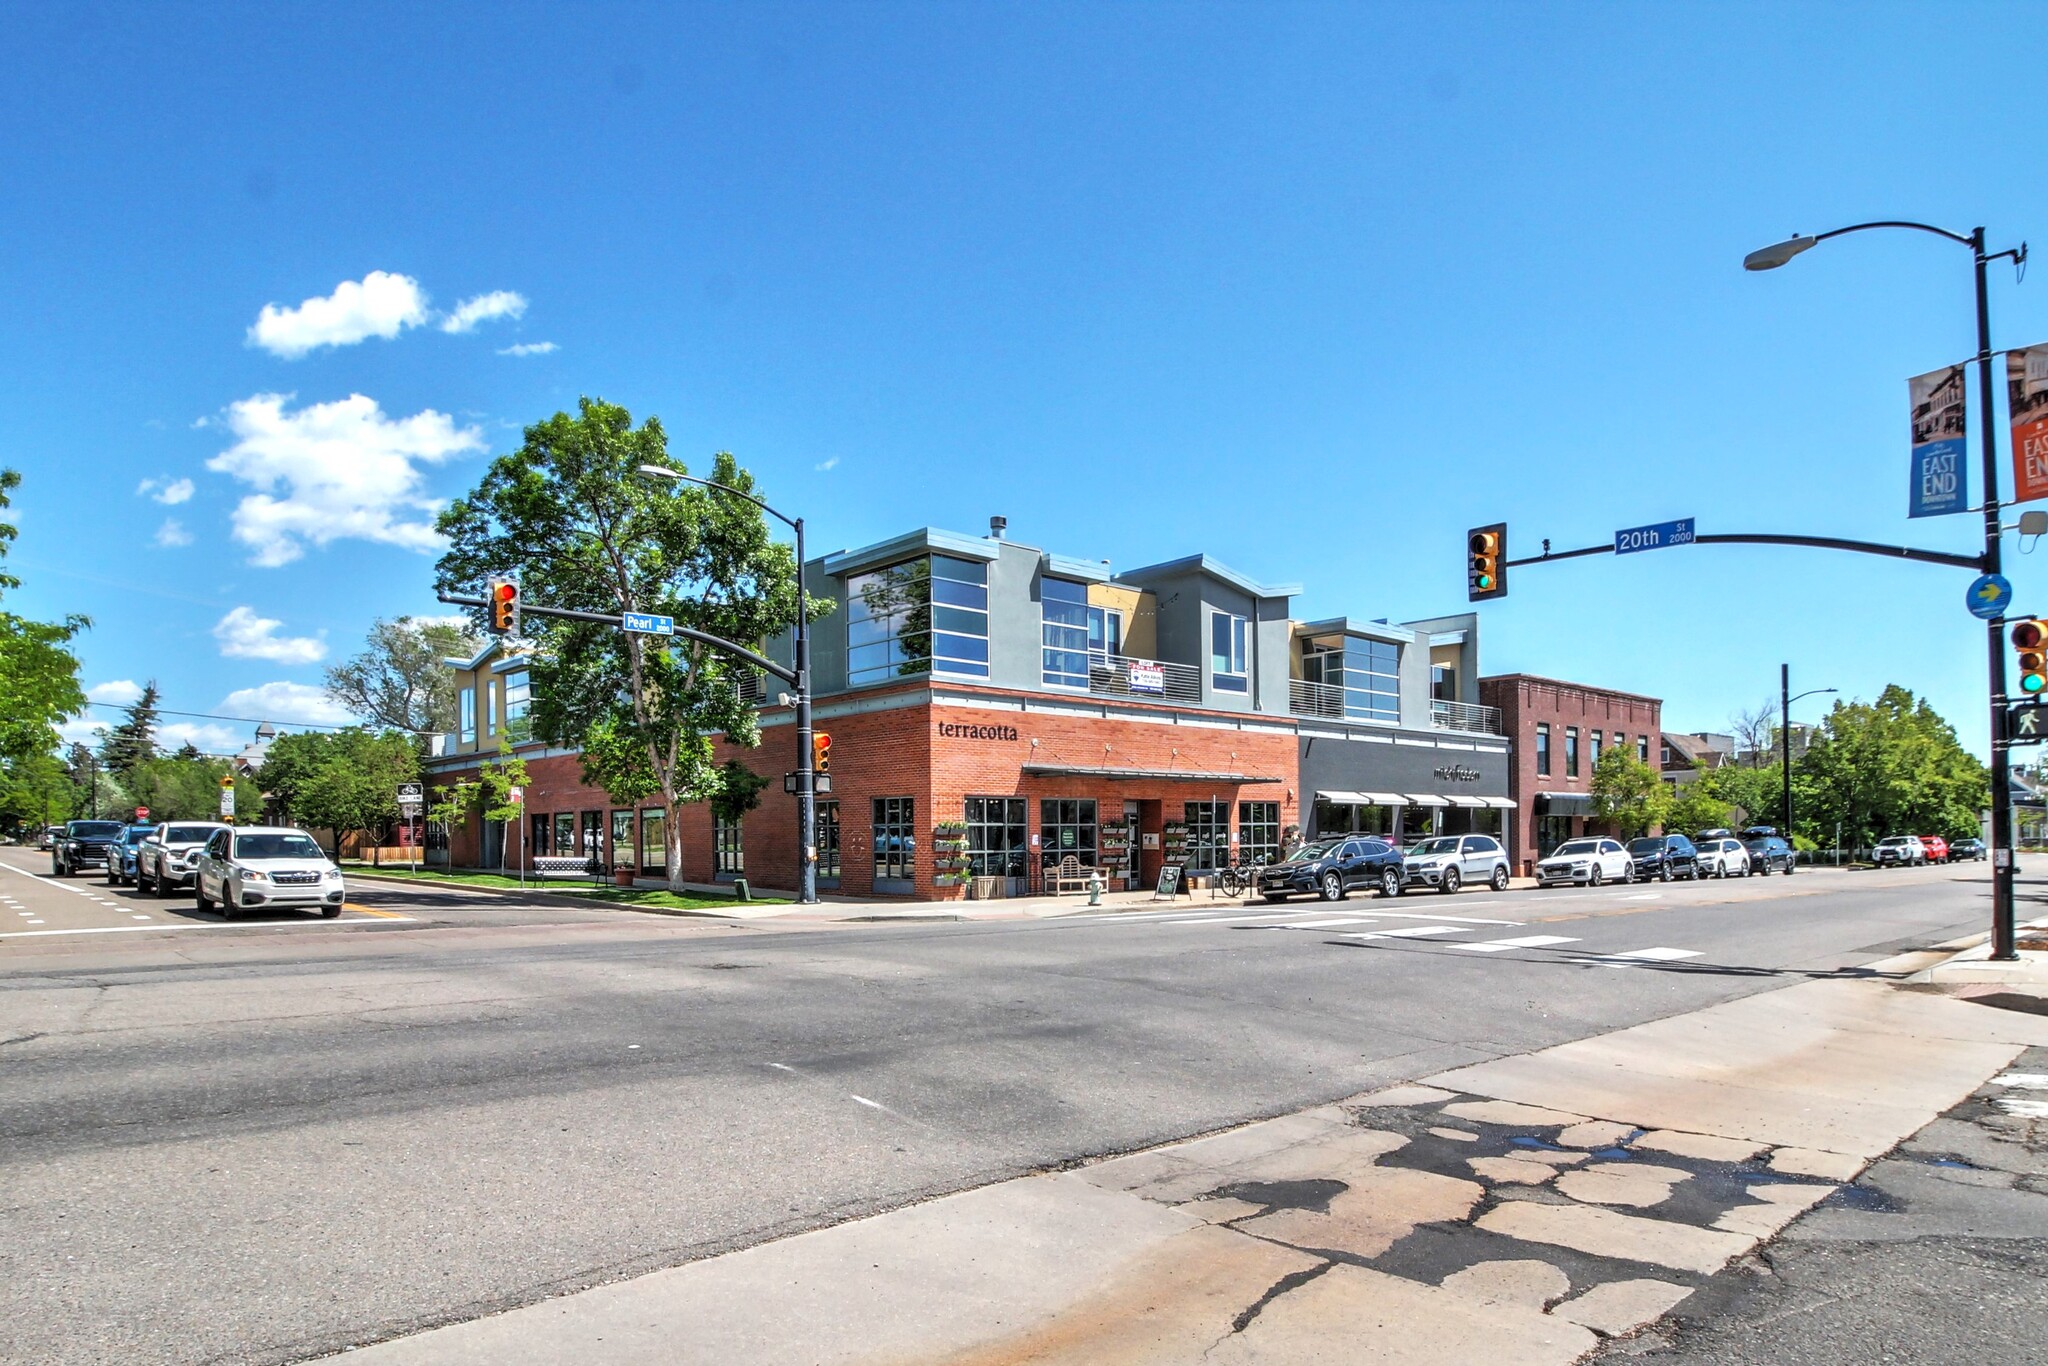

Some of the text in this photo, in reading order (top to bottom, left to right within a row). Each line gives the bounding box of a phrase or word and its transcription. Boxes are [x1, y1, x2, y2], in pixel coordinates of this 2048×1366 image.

[1922, 454, 1957, 476] EAST
[1922, 473, 1957, 496] END
[1669, 532, 1691, 543] 2000
[1676, 522, 1686, 532] St
[1620, 529, 1659, 550] 20th
[627, 615, 652, 629] Pearl
[938, 720, 1018, 741] terracotta
